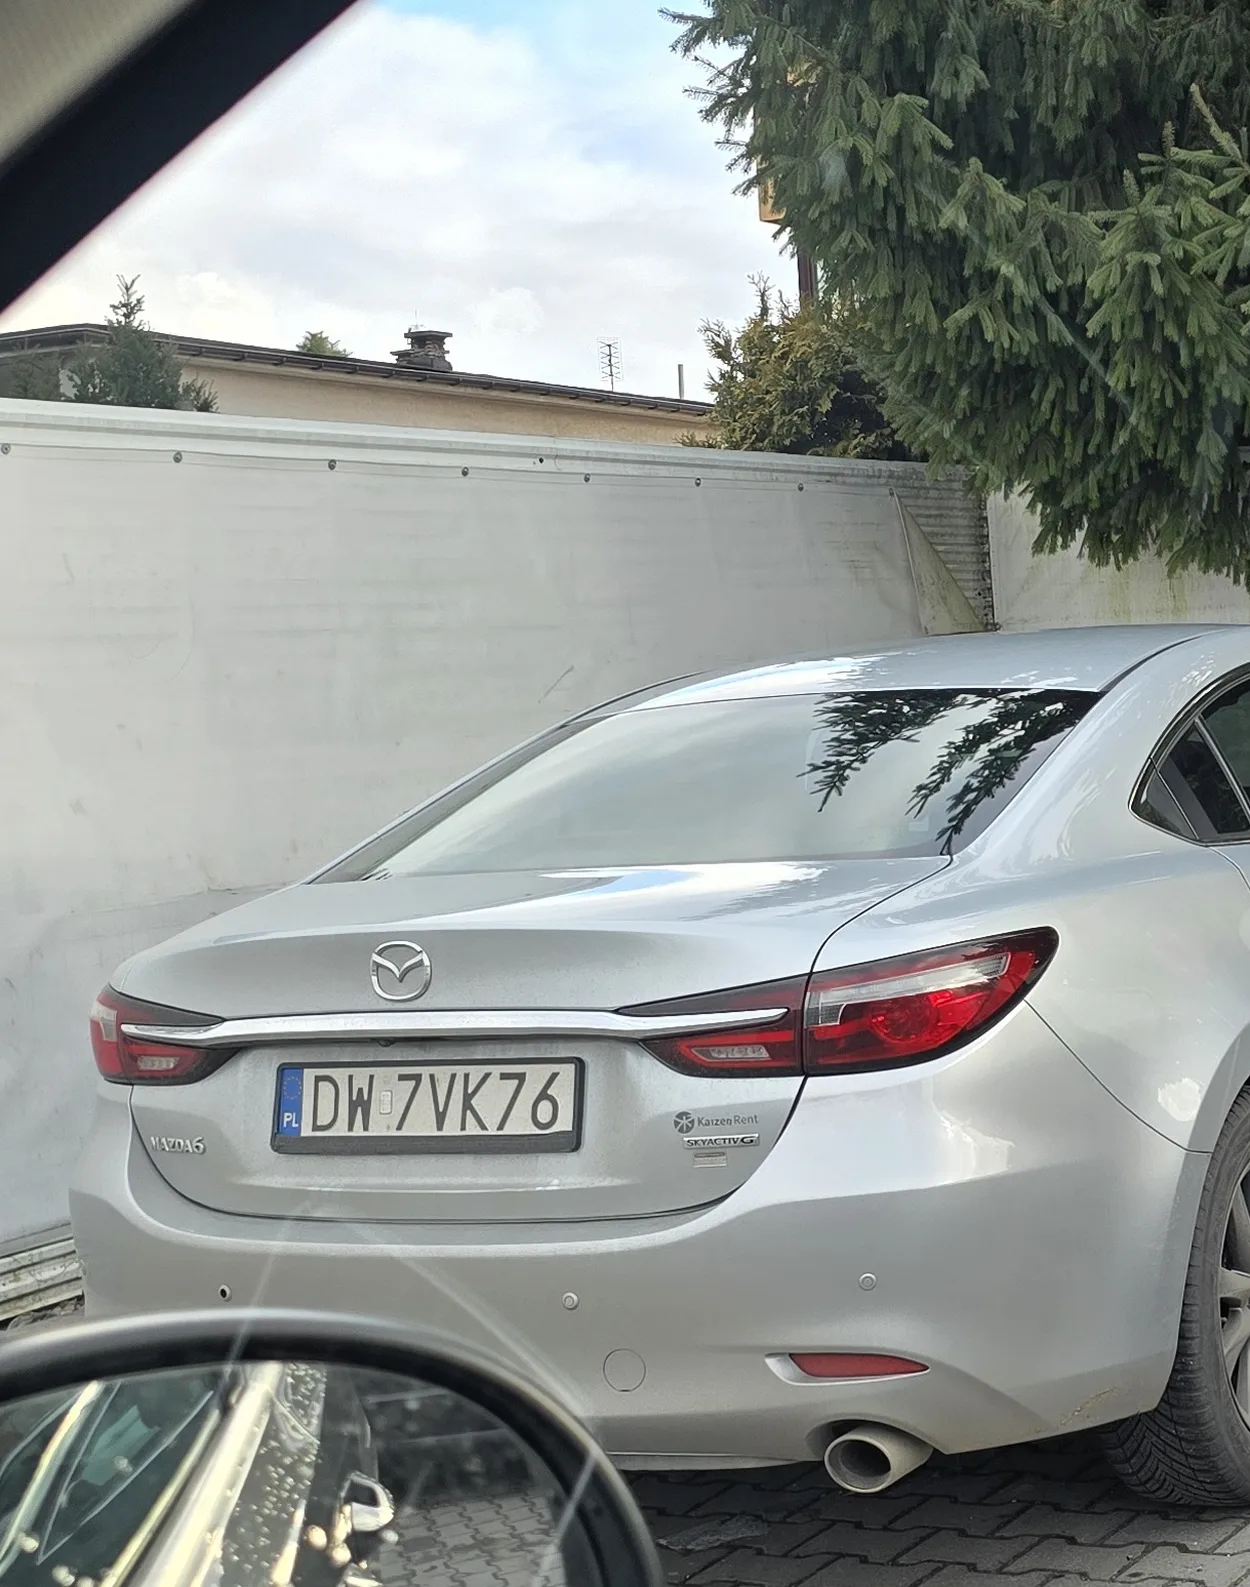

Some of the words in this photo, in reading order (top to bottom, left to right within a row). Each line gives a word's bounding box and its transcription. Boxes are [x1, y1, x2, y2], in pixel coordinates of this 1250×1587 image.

[311, 1073, 375, 1132] DW
[395, 1071, 561, 1132] 7VK76
[283, 1112, 299, 1128] PL
[733, 1114, 759, 1125] Rent
